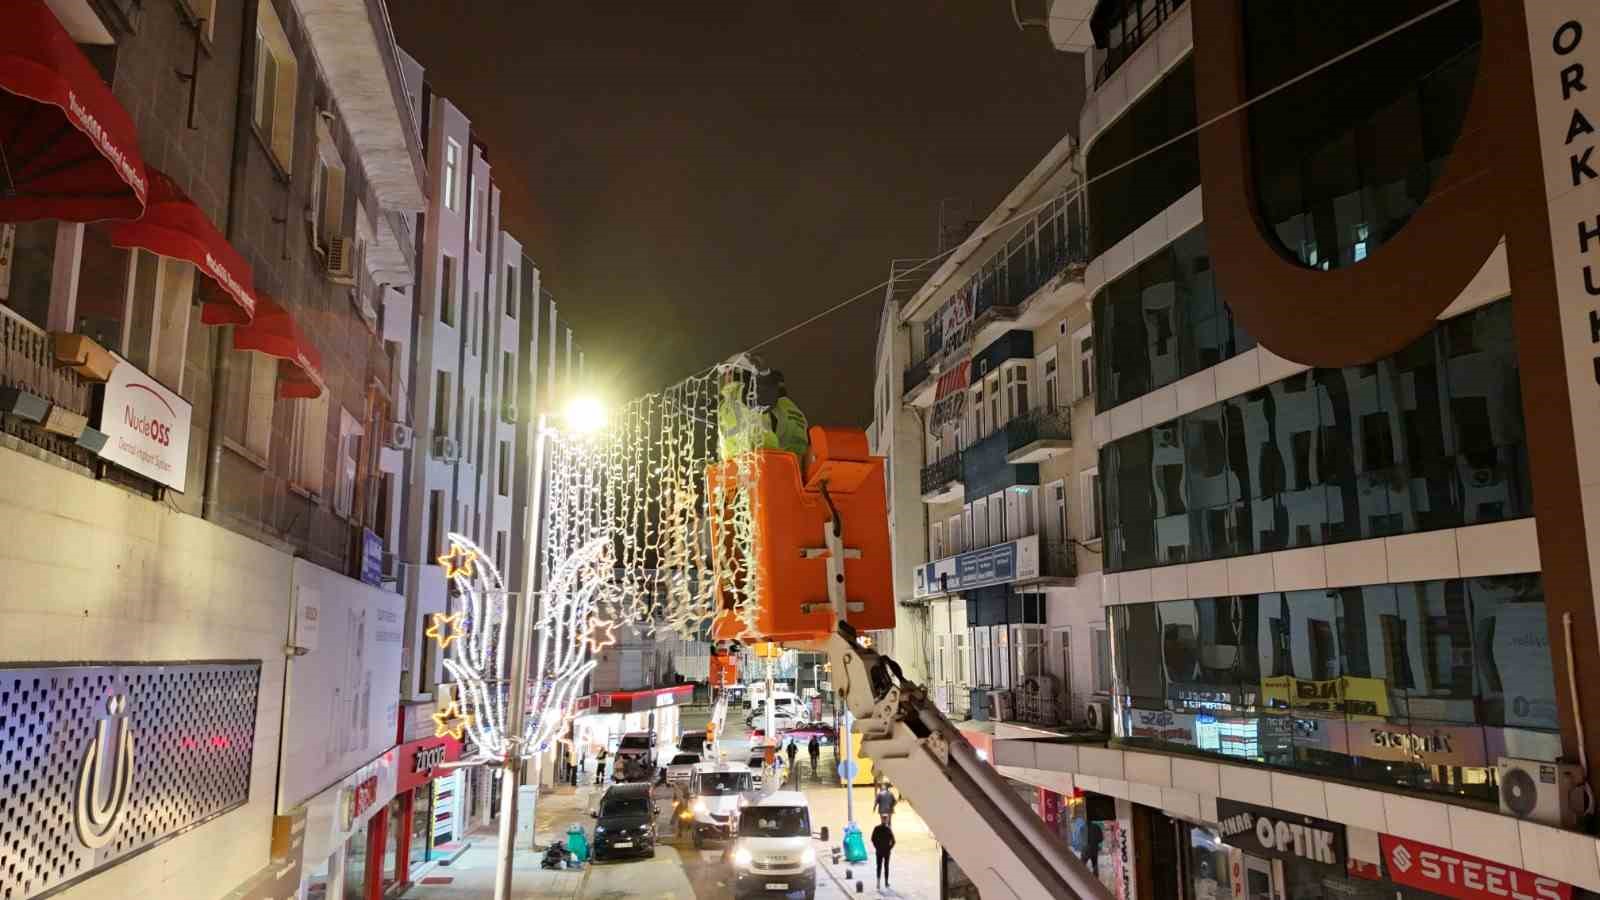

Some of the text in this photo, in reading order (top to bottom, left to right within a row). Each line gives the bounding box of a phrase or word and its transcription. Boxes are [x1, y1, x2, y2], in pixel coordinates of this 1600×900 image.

[1552, 20, 1599, 187] ORAK
[124, 404, 170, 447] NucleOSS
[1256, 816, 1337, 864] OPTİK
[1418, 850, 1561, 900] STEELS
